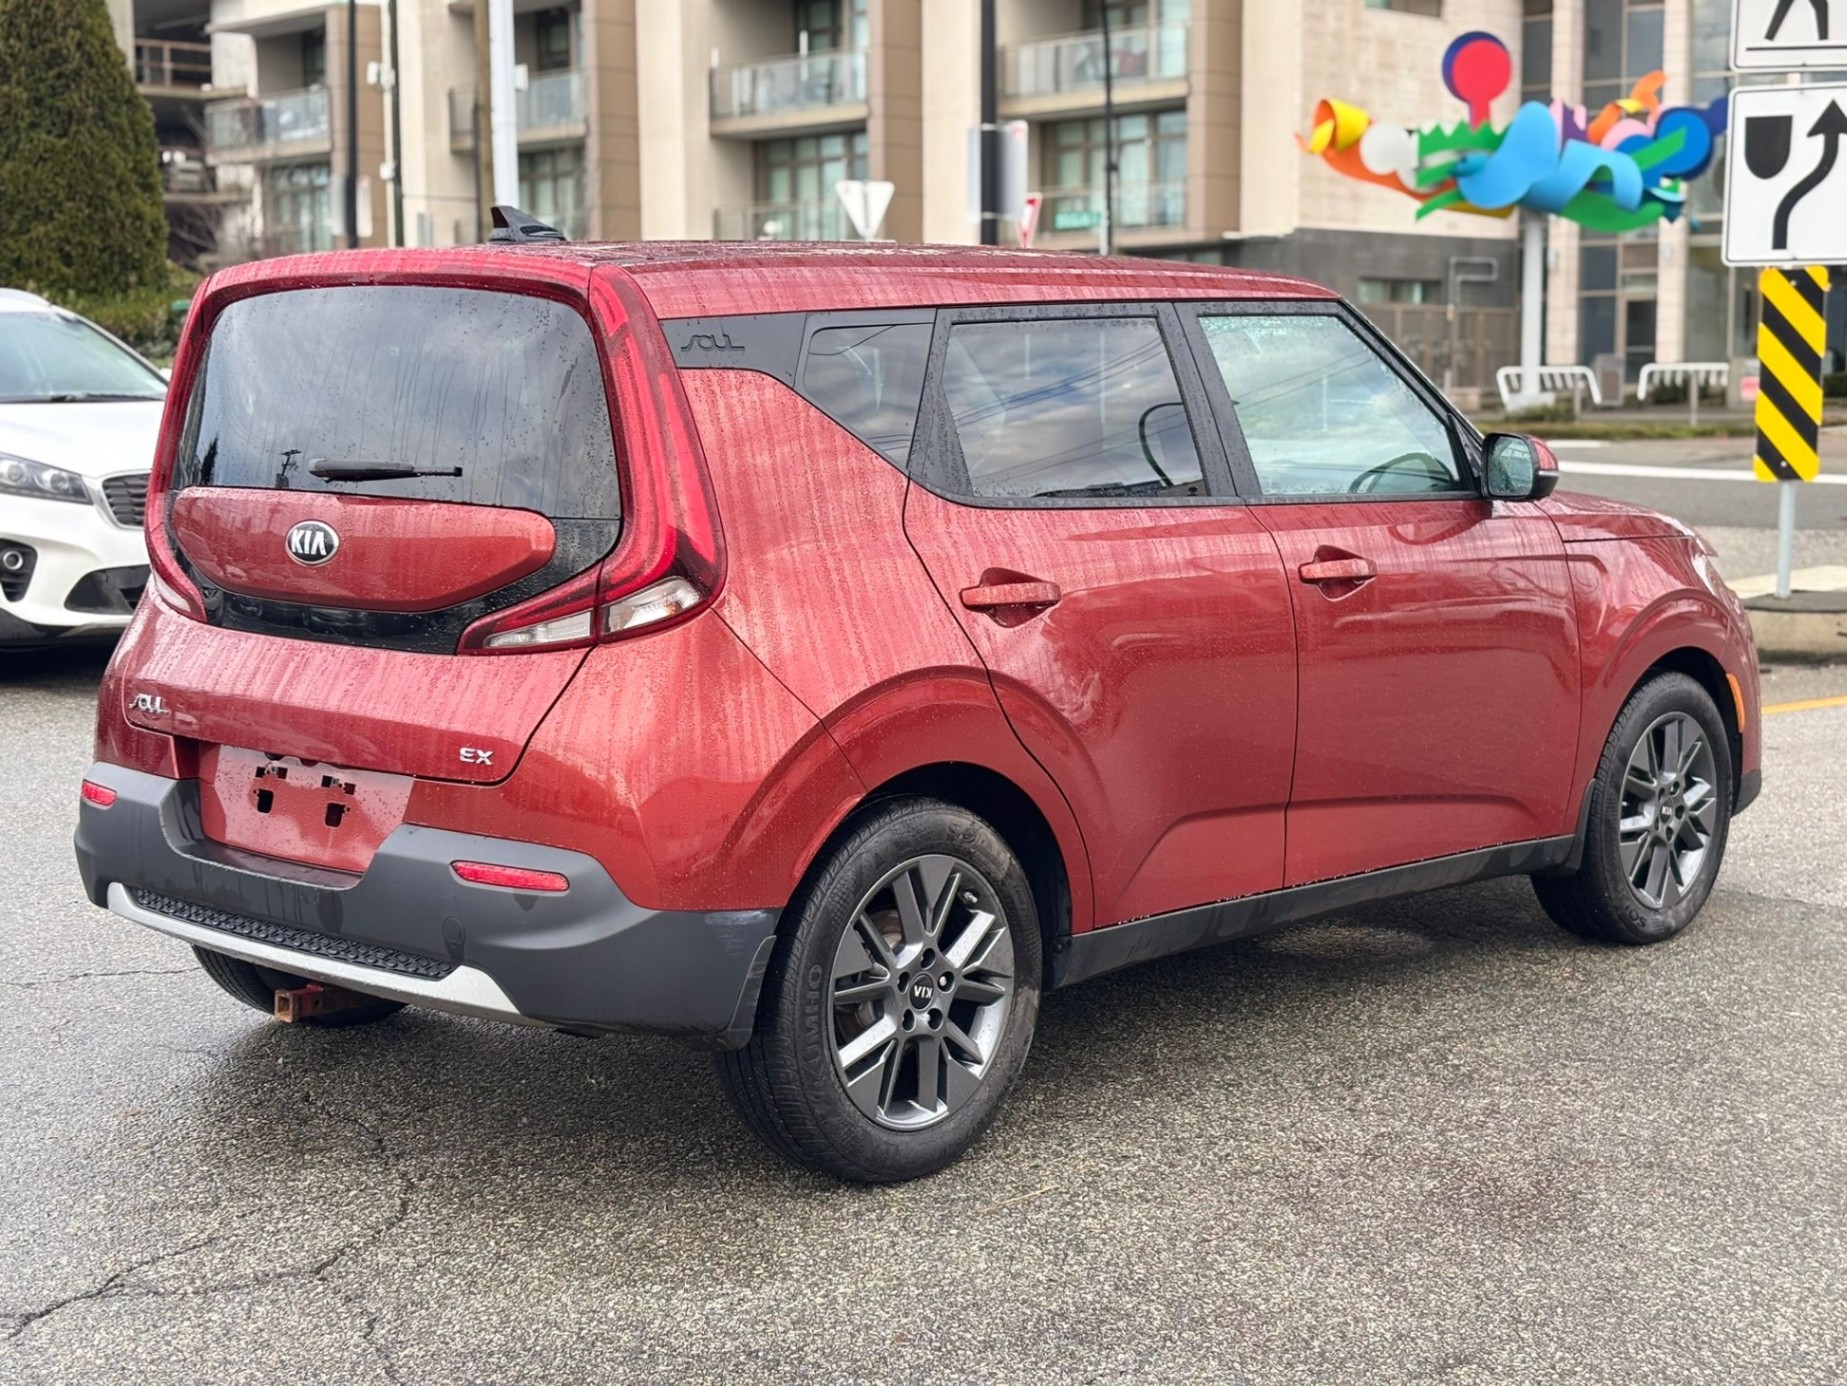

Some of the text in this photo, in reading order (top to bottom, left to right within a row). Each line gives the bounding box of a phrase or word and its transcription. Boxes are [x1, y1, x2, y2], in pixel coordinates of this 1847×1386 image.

[290, 528, 327, 556] KIA
[459, 746, 494, 766] EX
[914, 984, 933, 999] KIA
